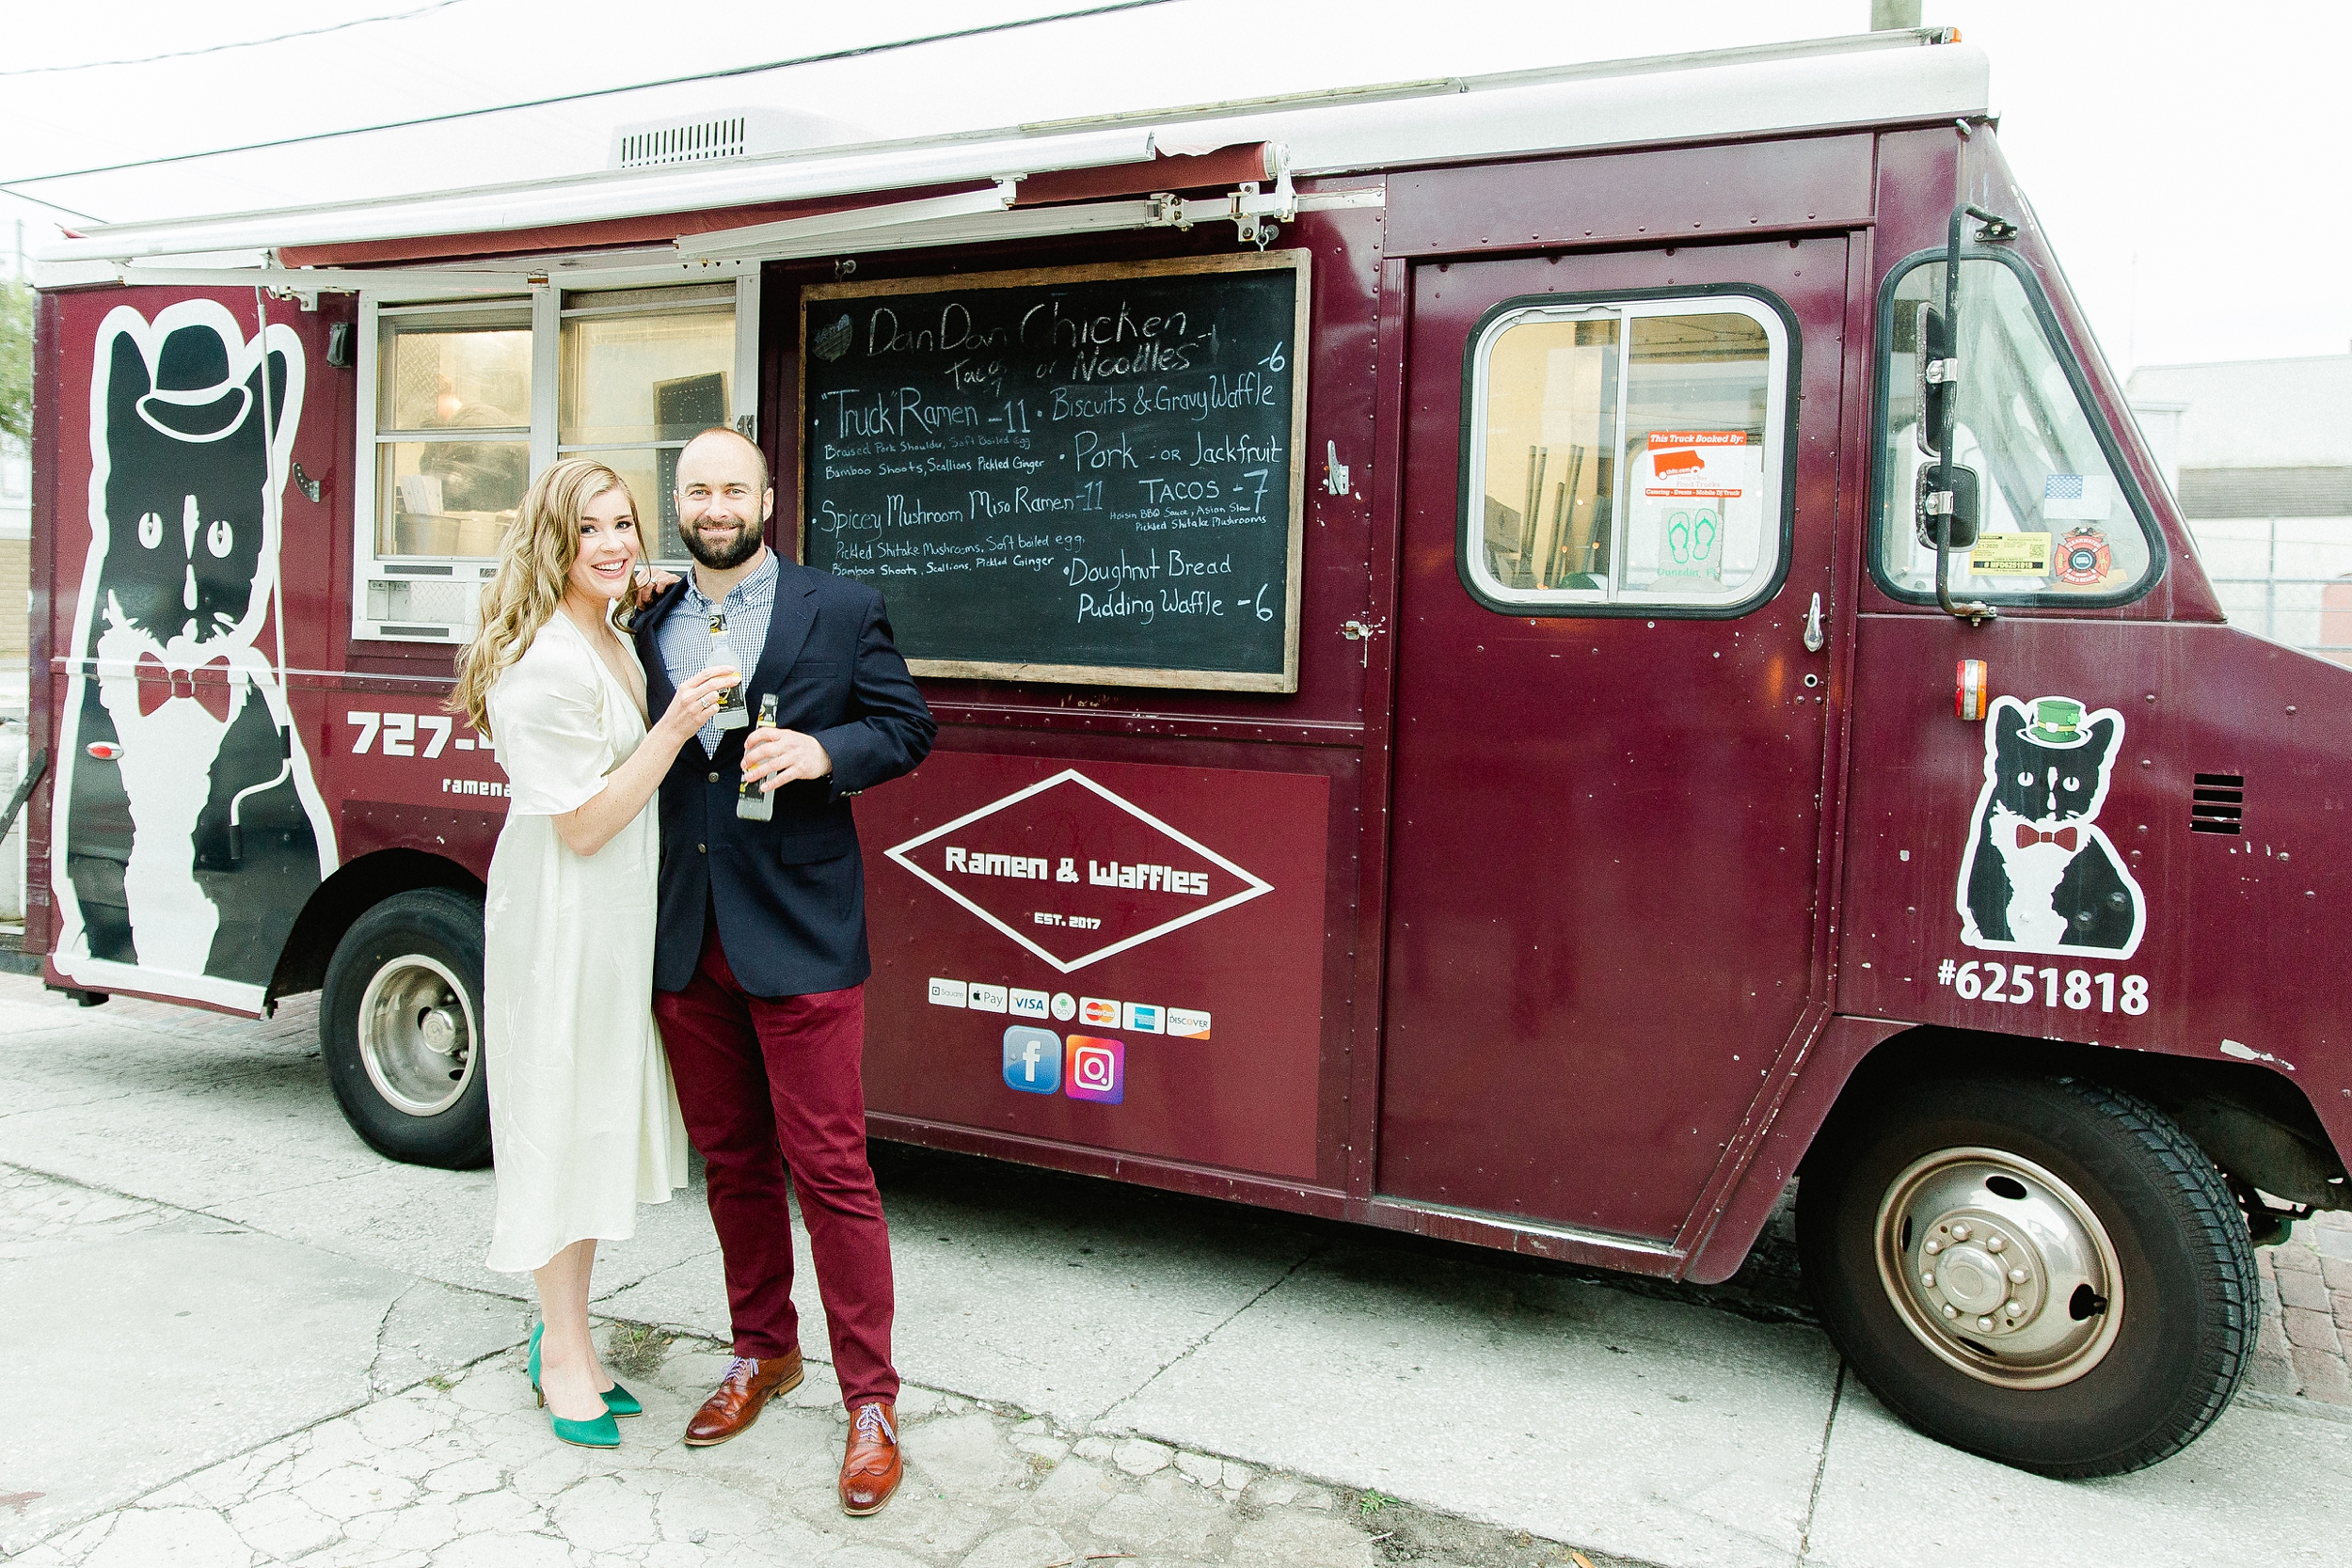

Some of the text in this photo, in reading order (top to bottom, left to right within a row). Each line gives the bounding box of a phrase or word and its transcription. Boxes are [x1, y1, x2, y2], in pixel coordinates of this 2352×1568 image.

[867, 308, 932, 356] Dan
[1021, 300, 1185, 348] Chicken
[1073, 341, 1199, 381] Noodles
[1050, 372, 1276, 421] Biscuits & Gravy Waffle
[900, 387, 978, 436] Ramen
[824, 442, 871, 460] Braised
[876, 441, 896, 453] Pork
[948, 436, 975, 448] Soft
[977, 436, 1009, 447] Boiled
[1074, 430, 1139, 472] Pork
[1189, 431, 1282, 467] Jackfruit
[1650, 435, 1743, 445] This Truck Booked By:
[825, 466, 871, 480] Bamboo
[927, 457, 972, 472] Scallions
[977, 456, 1009, 470] Pickled
[1012, 456, 1045, 474] Ginger
[1138, 478, 1219, 504] TACOS
[820, 500, 882, 543] Spicey
[887, 494, 963, 528] Mushroom
[969, 490, 1010, 520] Miso
[1015, 485, 1074, 514] Ramen
[1110, 511, 1137, 520] Hoisin
[1140, 508, 1160, 518] BBQ
[1196, 505, 1226, 515] Asian
[1230, 501, 1250, 513] Slaw
[1136, 515, 1267, 531] Pickled Shitake Mushrooms
[835, 542, 872, 560] Pickled
[877, 541, 920, 559] Shitake
[986, 535, 1014, 552] Soft
[1019, 533, 1049, 548] boiled
[832, 562, 875, 576] Bamboo
[976, 557, 1008, 568] Pickled
[1013, 554, 1055, 572] Ginger
[1069, 547, 1232, 592] Doughnut Bread
[1077, 591, 1154, 626] Pudding
[1159, 588, 1224, 616] Waffle
[946, 847, 1209, 896] Ramen & Waffles
[1034, 912, 1102, 930] EST. 2017
[941, 988, 964, 1000] Square
[983, 991, 1004, 1007] Pay
[1938, 958, 2150, 1016] #6251818
[1013, 996, 1044, 1012] VISA
[1057, 1007, 1071, 1018] pay
[1169, 1016, 1208, 1029] DISCOVER
